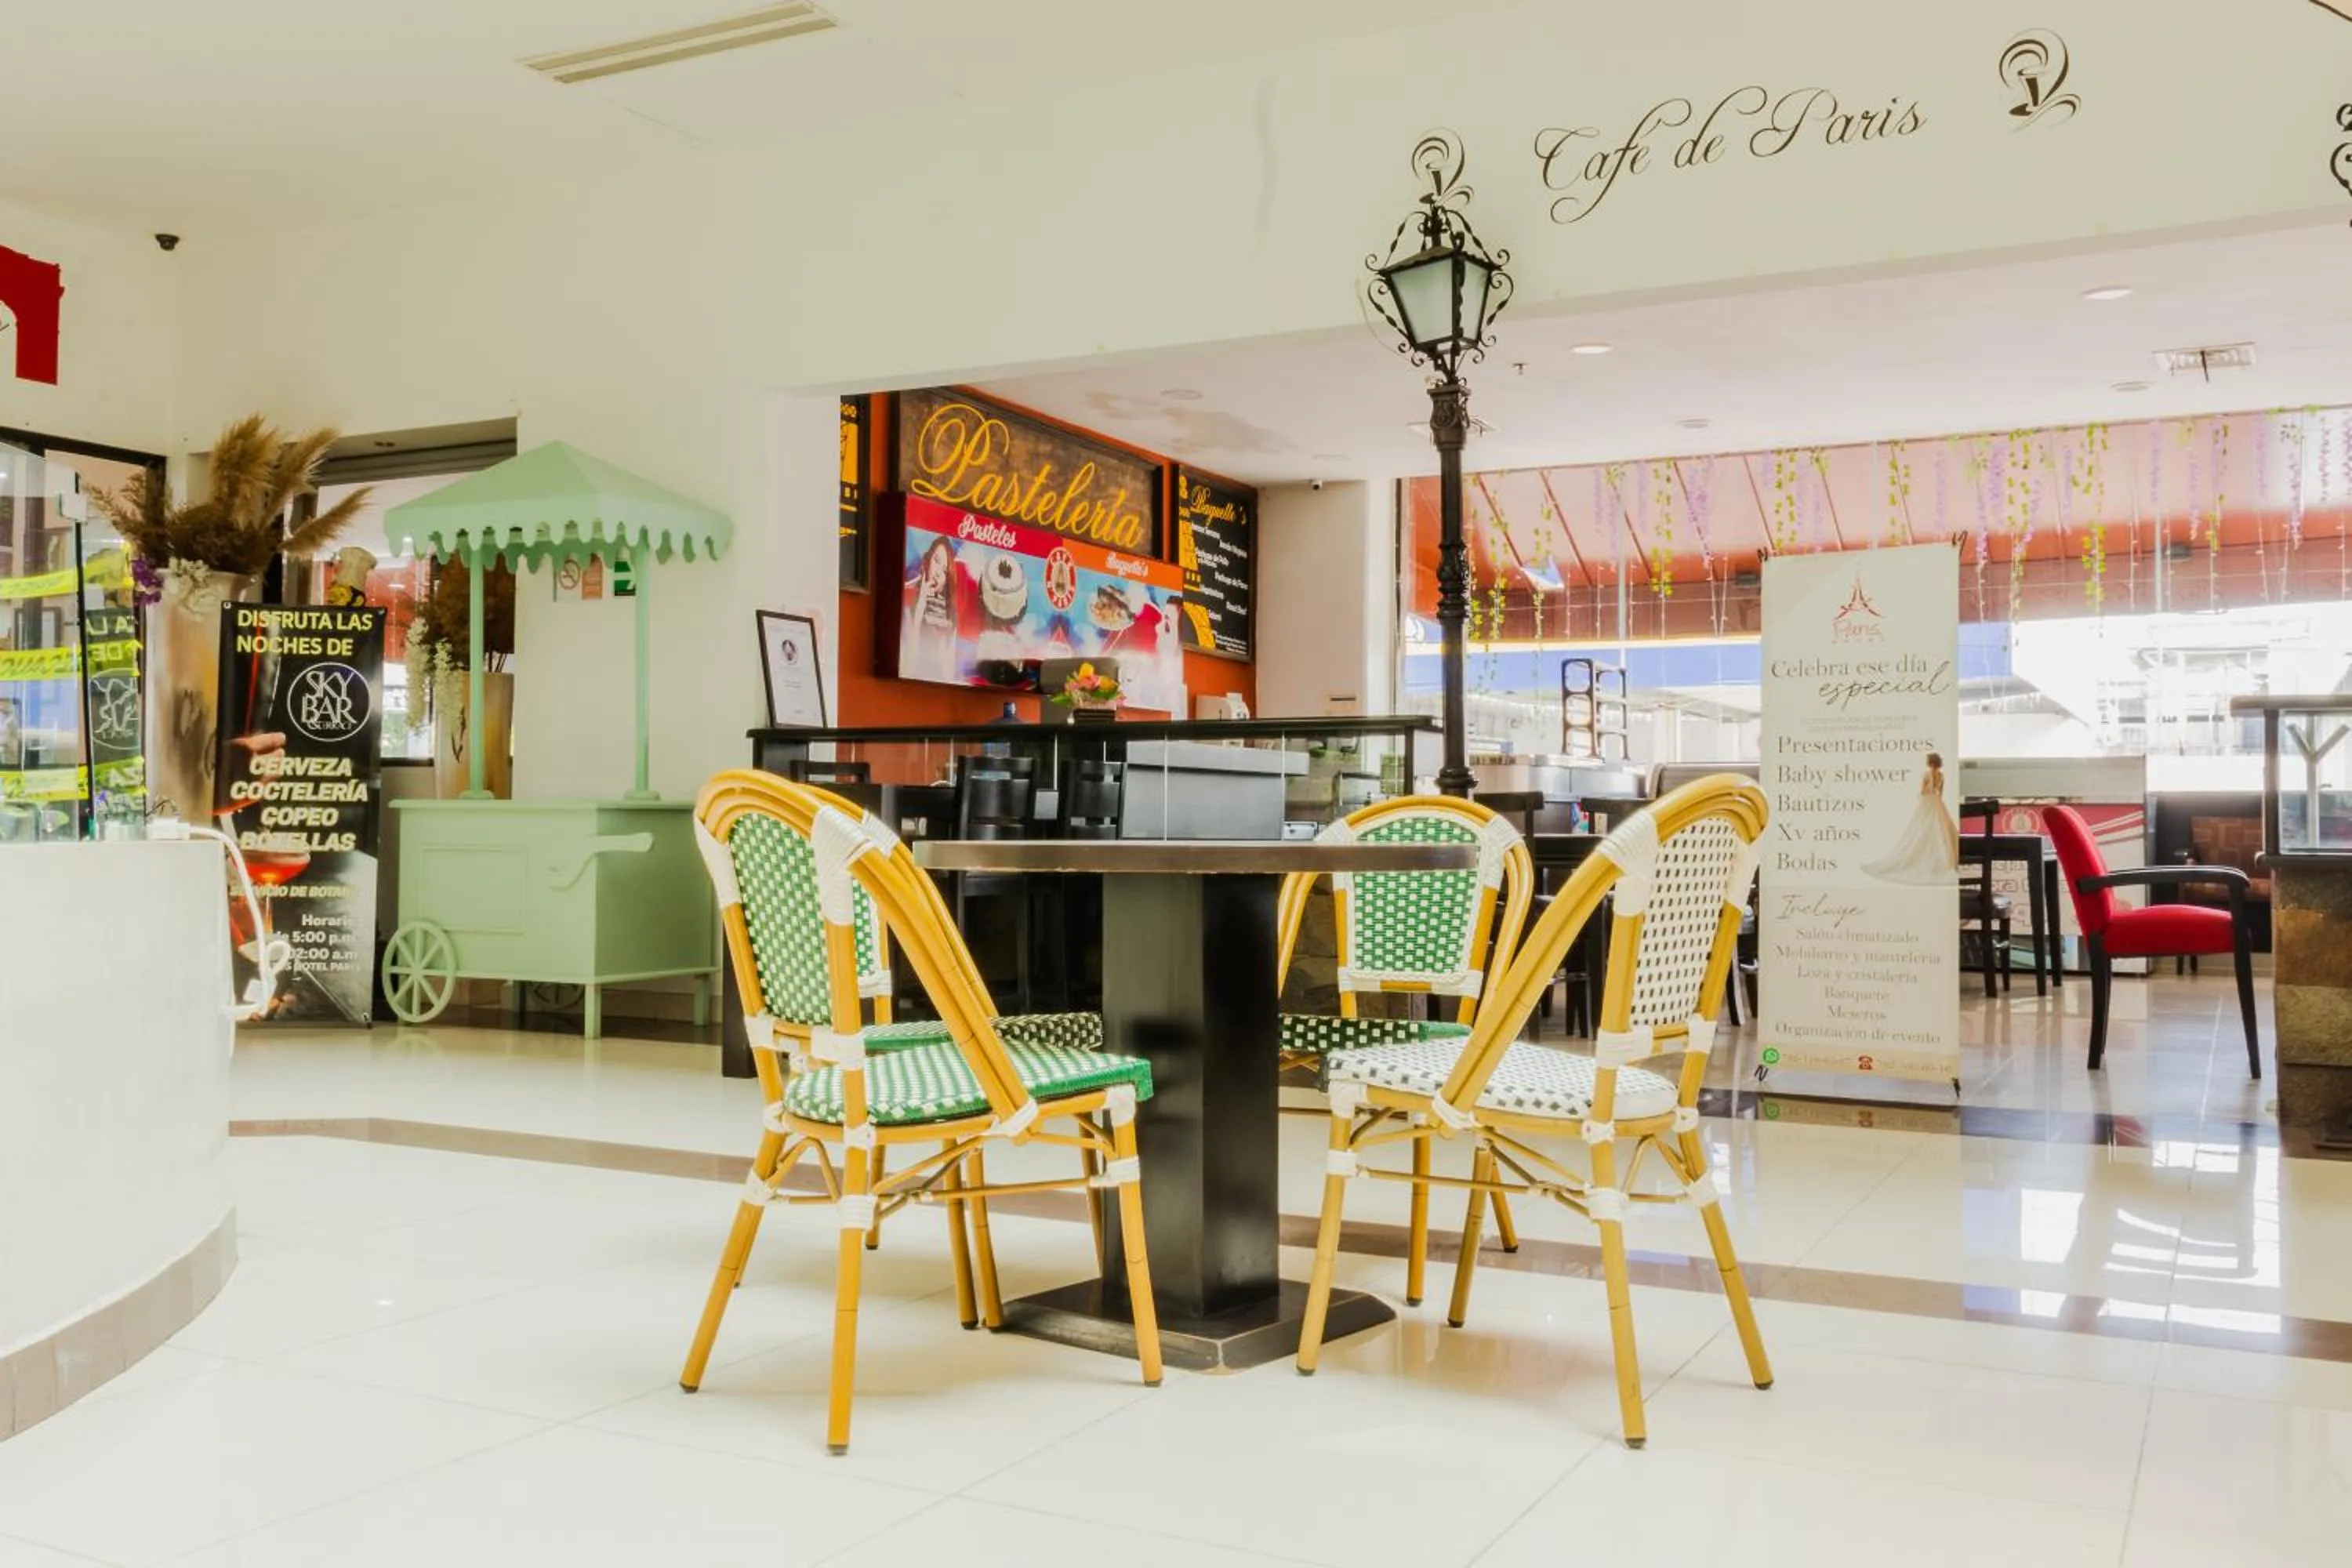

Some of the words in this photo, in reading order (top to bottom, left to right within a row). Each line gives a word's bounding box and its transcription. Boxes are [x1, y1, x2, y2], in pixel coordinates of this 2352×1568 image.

[1674, 85, 1767, 169] de
[1749, 85, 1929, 158] Paris
[958, 514, 1017, 547] Pasteles
[238, 609, 333, 630] DISFRUTA
[336, 612, 374, 631] LAS
[236, 635, 322, 655] NOCHES
[327, 637, 354, 656] DE
[1771, 658, 1849, 678] Celebra
[1856, 662, 1889, 675] ese
[1896, 653, 1927, 673] día
[305, 670, 355, 699] SKY
[1818, 660, 1951, 711] especial
[301, 695, 358, 724] BAR
[1777, 734, 1935, 753] Presentaciones
[249, 755, 353, 777] CERVEZA
[1777, 764, 1827, 789] Baby
[1835, 764, 1911, 782] shower
[230, 779, 368, 802] COCTELERÍA
[1777, 794, 1866, 812] Bautizos
[260, 807, 339, 827] COPEO
[239, 830, 357, 851] BOTELLAS
[1813, 825, 1861, 840] años
[1777, 852, 1838, 870] Bodas
[289, 886, 308, 897] DE
[1774, 892, 1864, 929] Incluye
[292, 931, 326, 942] 5:00
[1828, 1005, 1887, 1020] Meseros
[1871, 1028, 1889, 1041] de
